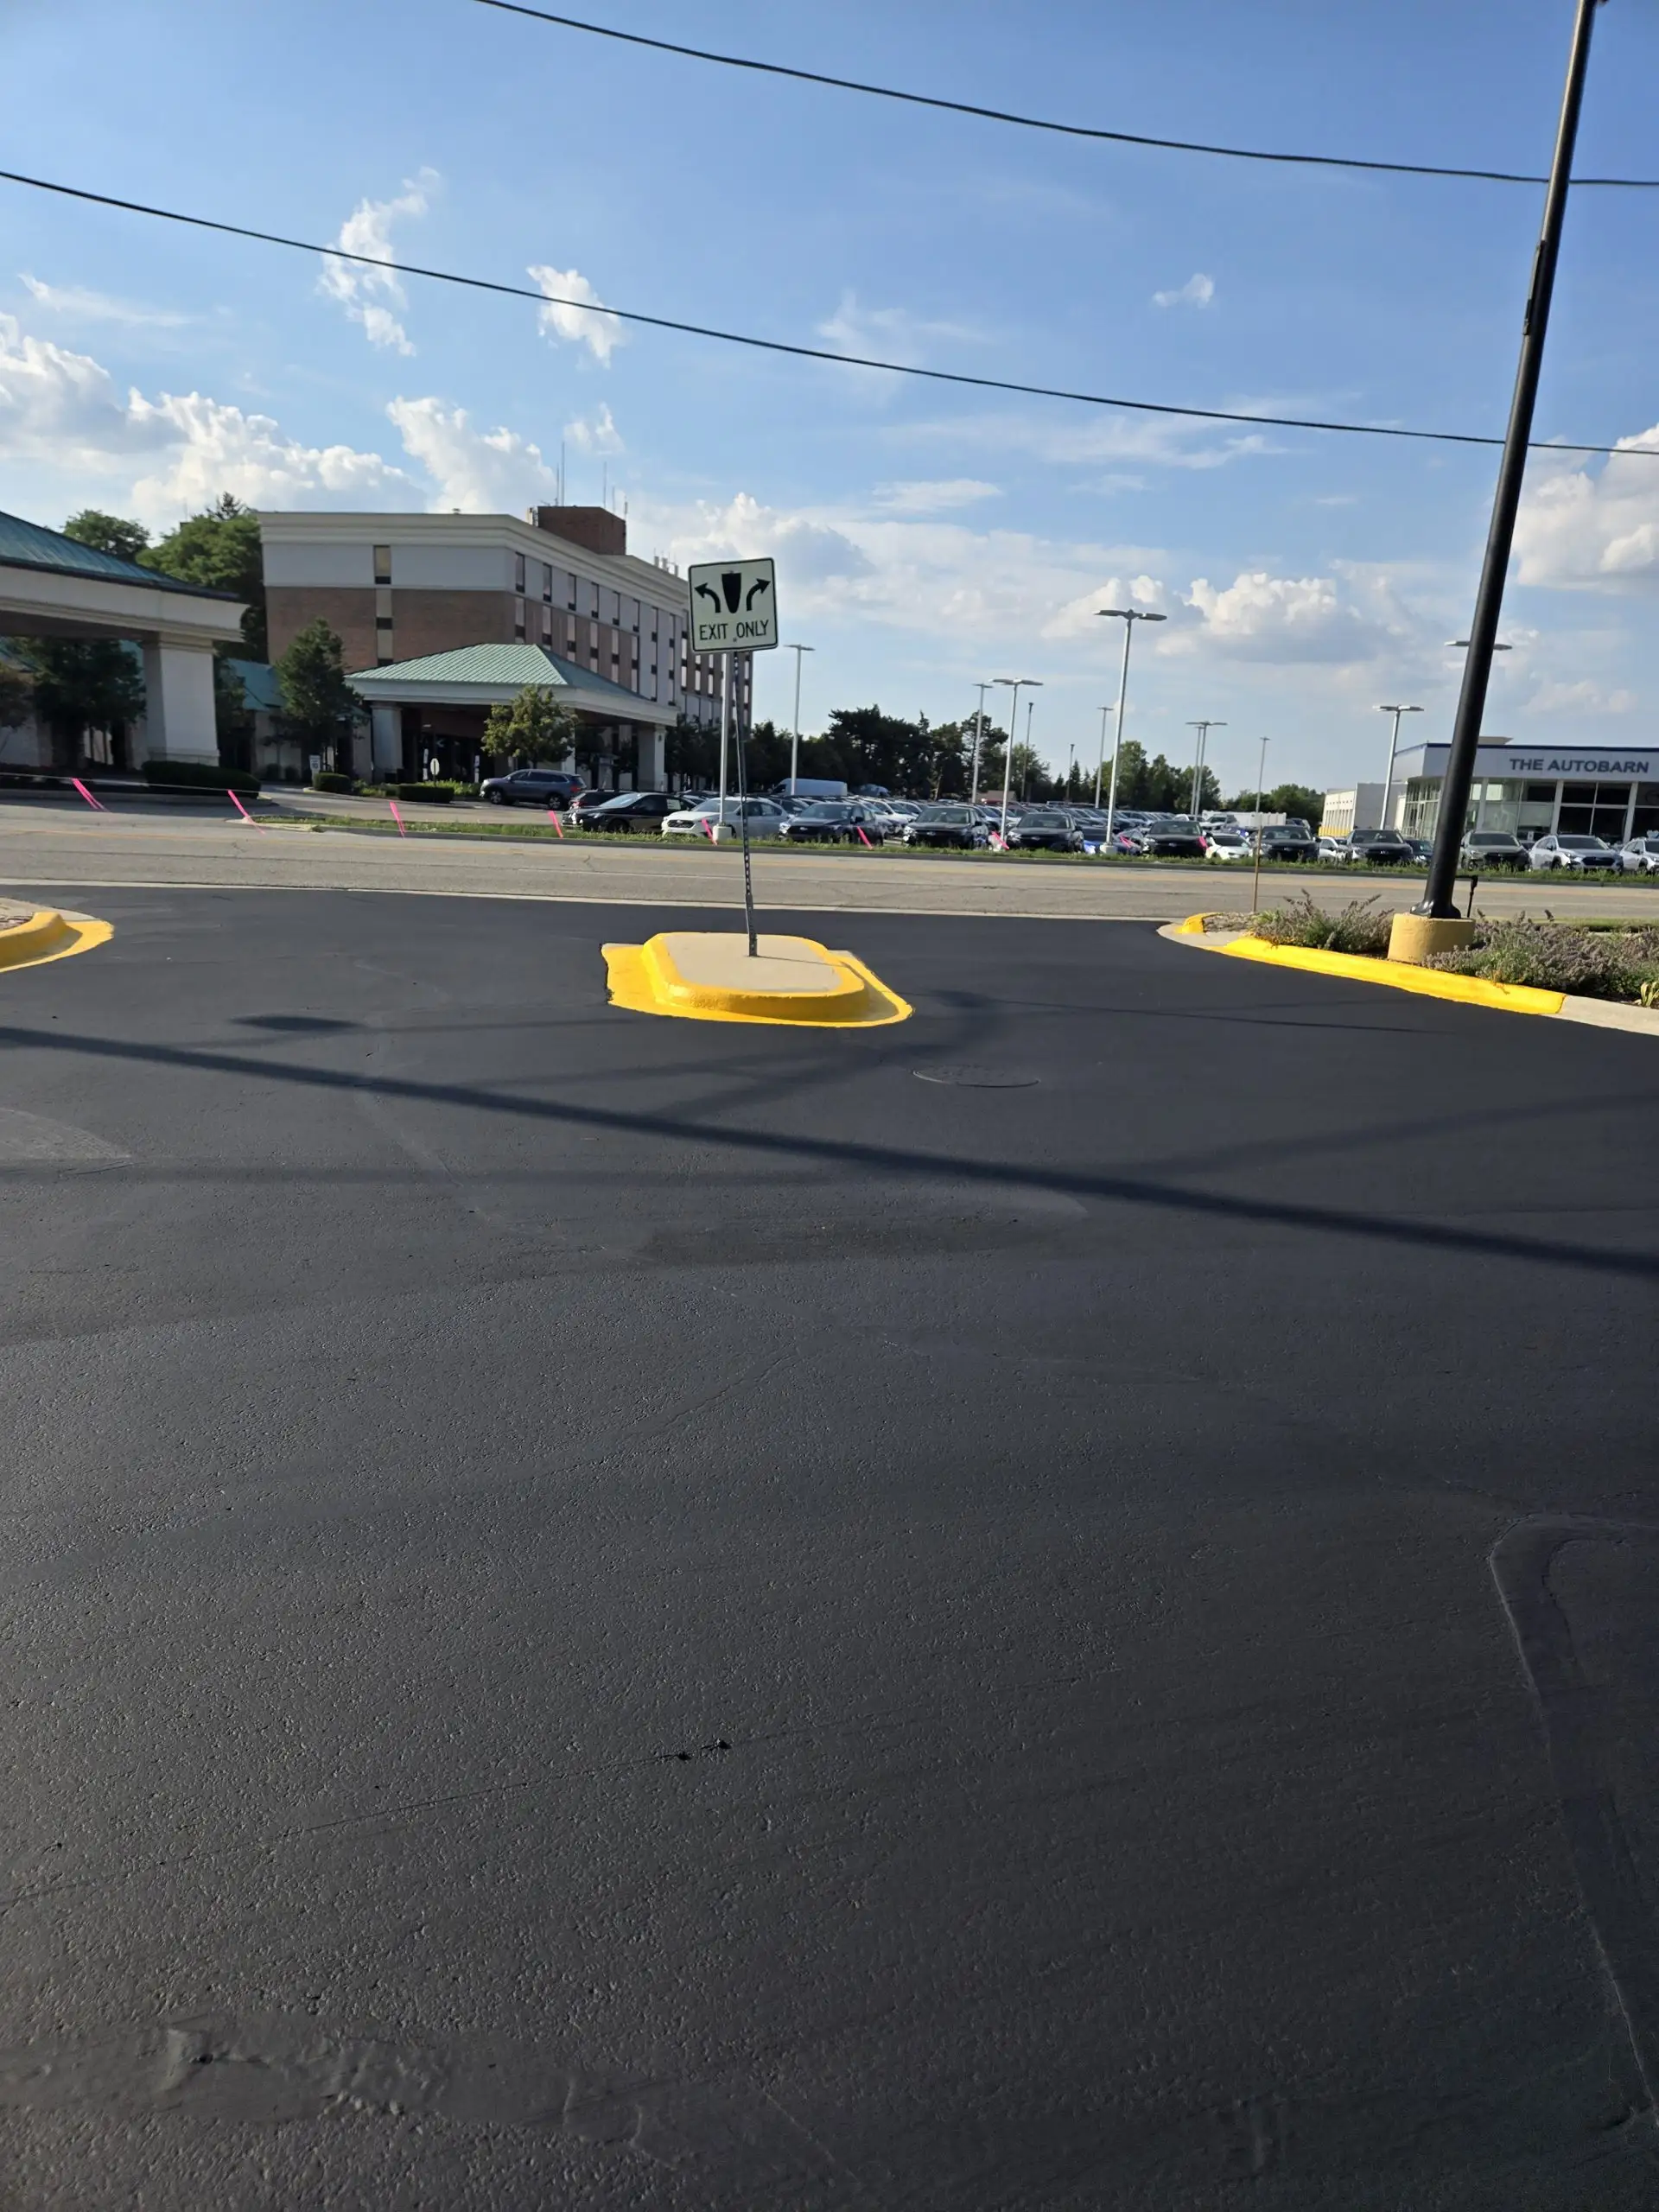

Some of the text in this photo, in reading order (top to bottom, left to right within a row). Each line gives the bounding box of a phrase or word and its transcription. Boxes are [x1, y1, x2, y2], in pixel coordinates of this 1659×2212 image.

[699, 619, 769, 641] EXIT ONLY
[1510, 758, 1649, 773] THE AUTOBARN
